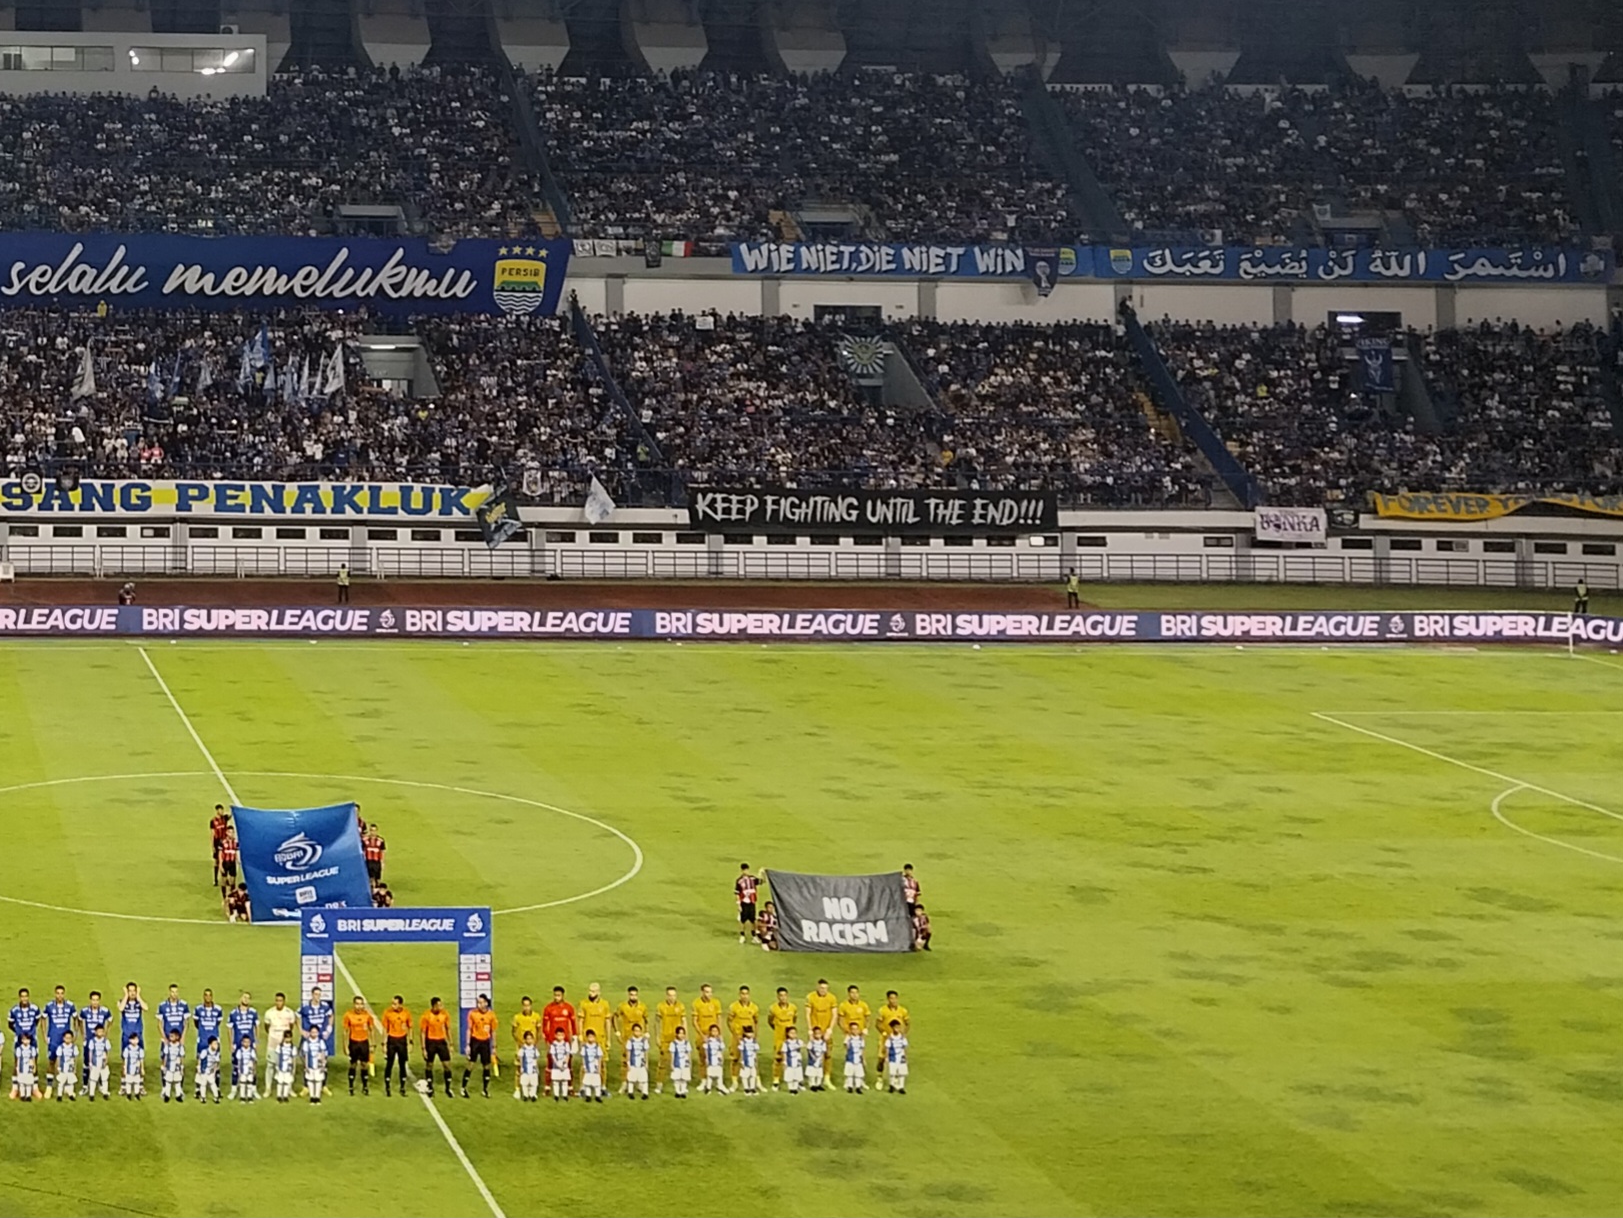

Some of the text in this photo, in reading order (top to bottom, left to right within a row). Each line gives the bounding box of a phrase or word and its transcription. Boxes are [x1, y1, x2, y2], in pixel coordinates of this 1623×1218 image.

[1, 243, 150, 297] selalu
[162, 247, 478, 299] memelukmu
[501, 267, 540, 278] PERSIB
[1, 481, 152, 512] SANG
[177, 483, 471, 516] PENAKLUK
[695, 492, 1044, 526] KEEP FIGHTING UNTIL THE END!!!
[142, 609, 180, 631] BRI
[405, 610, 443, 632] BRI
[655, 613, 693, 634] BRI
[915, 614, 952, 635] BRI
[1160, 615, 1197, 637] BRI
[1414, 615, 1450, 637] BRI
[822, 897, 859, 921] NO
[337, 918, 361, 931] BRI
[801, 919, 889, 946] RACISM
